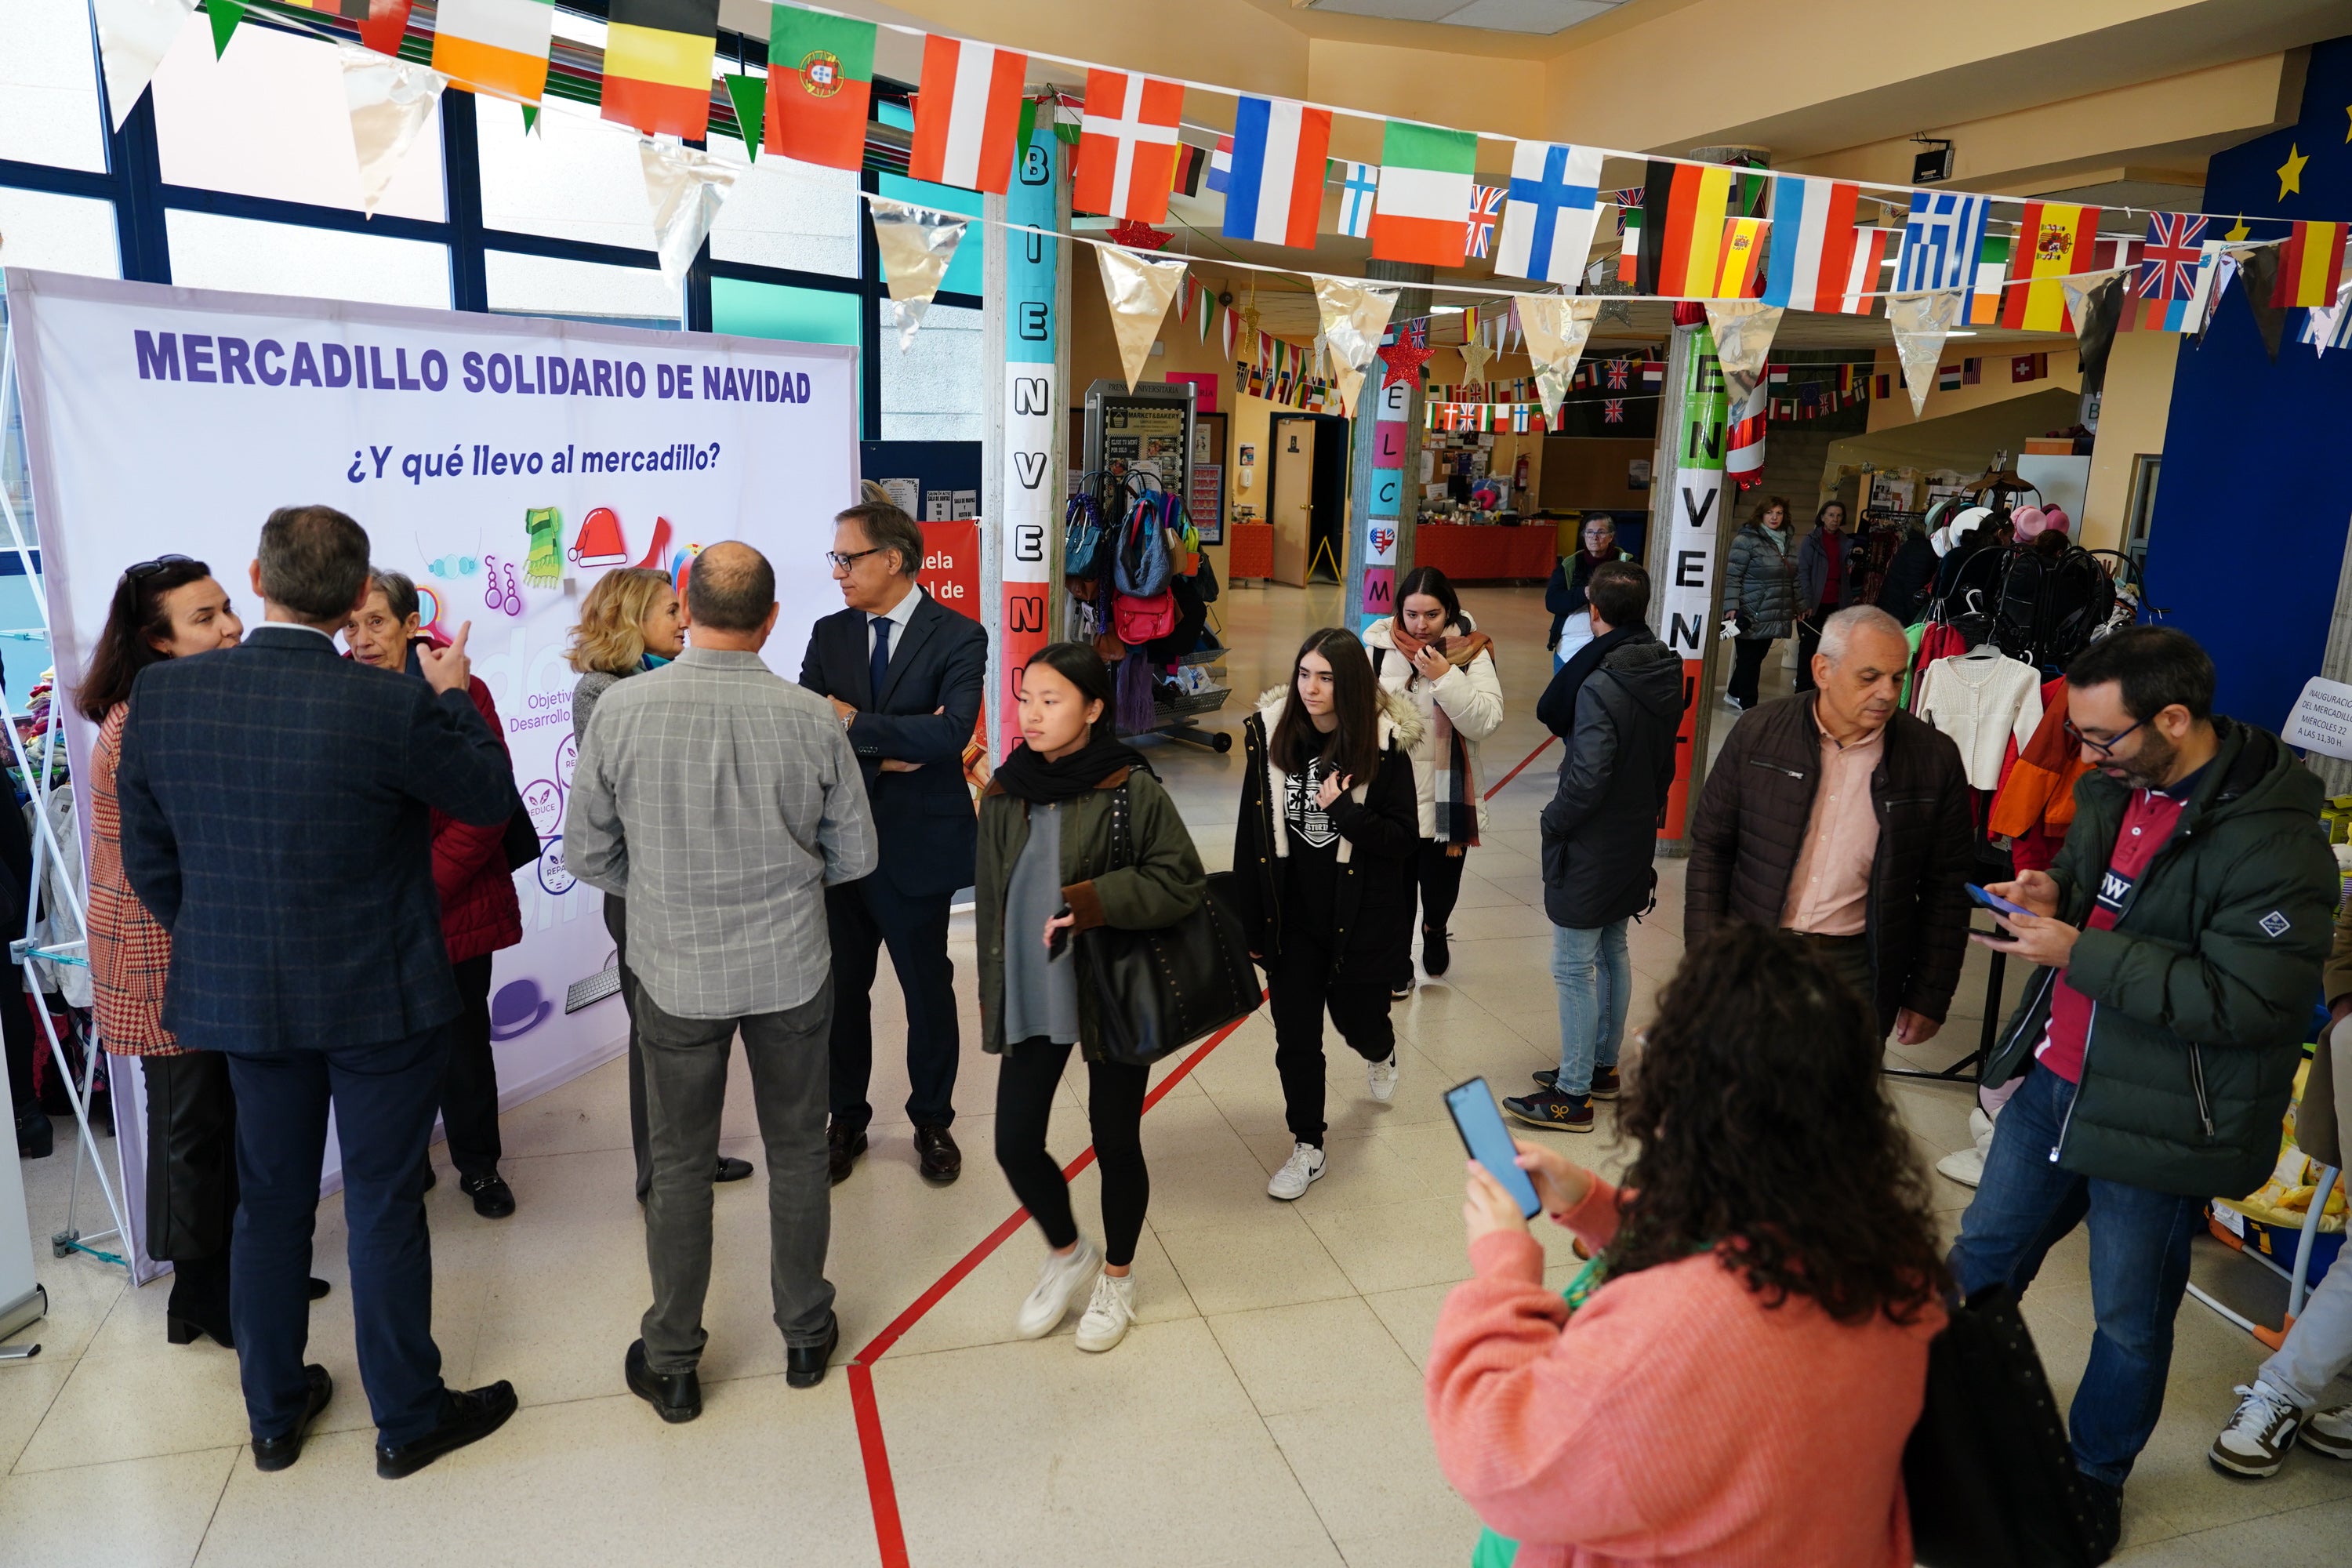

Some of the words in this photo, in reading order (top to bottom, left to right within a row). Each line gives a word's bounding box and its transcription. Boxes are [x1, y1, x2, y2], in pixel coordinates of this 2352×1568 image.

[134, 329, 448, 392] MERCADILLO
[463, 350, 646, 399] SOLIDARIO
[657, 363, 694, 400] DE
[702, 365, 811, 404] NAVIDAD
[1108, 383, 1129, 392] PRENS
[1134, 383, 1179, 394] NIVERSITARIA
[347, 445, 394, 484] ¿Y
[401, 444, 464, 485] qué
[473, 445, 543, 476] llevo
[550, 444, 575, 474] al
[581, 441, 720, 474] mercadillo?
[941, 580, 964, 599] de
[528, 689, 575, 710] Objetiv
[2302, 700, 2313, 711] DEL
[510, 708, 571, 733] Desarrollo
[2300, 714, 2336, 732] MIÉRCOLES
[2337, 726, 2347, 735] 22
[2297, 727, 2303, 735] A
[2303, 730, 2316, 739] LAS
[2317, 733, 2336, 745] 11,30
